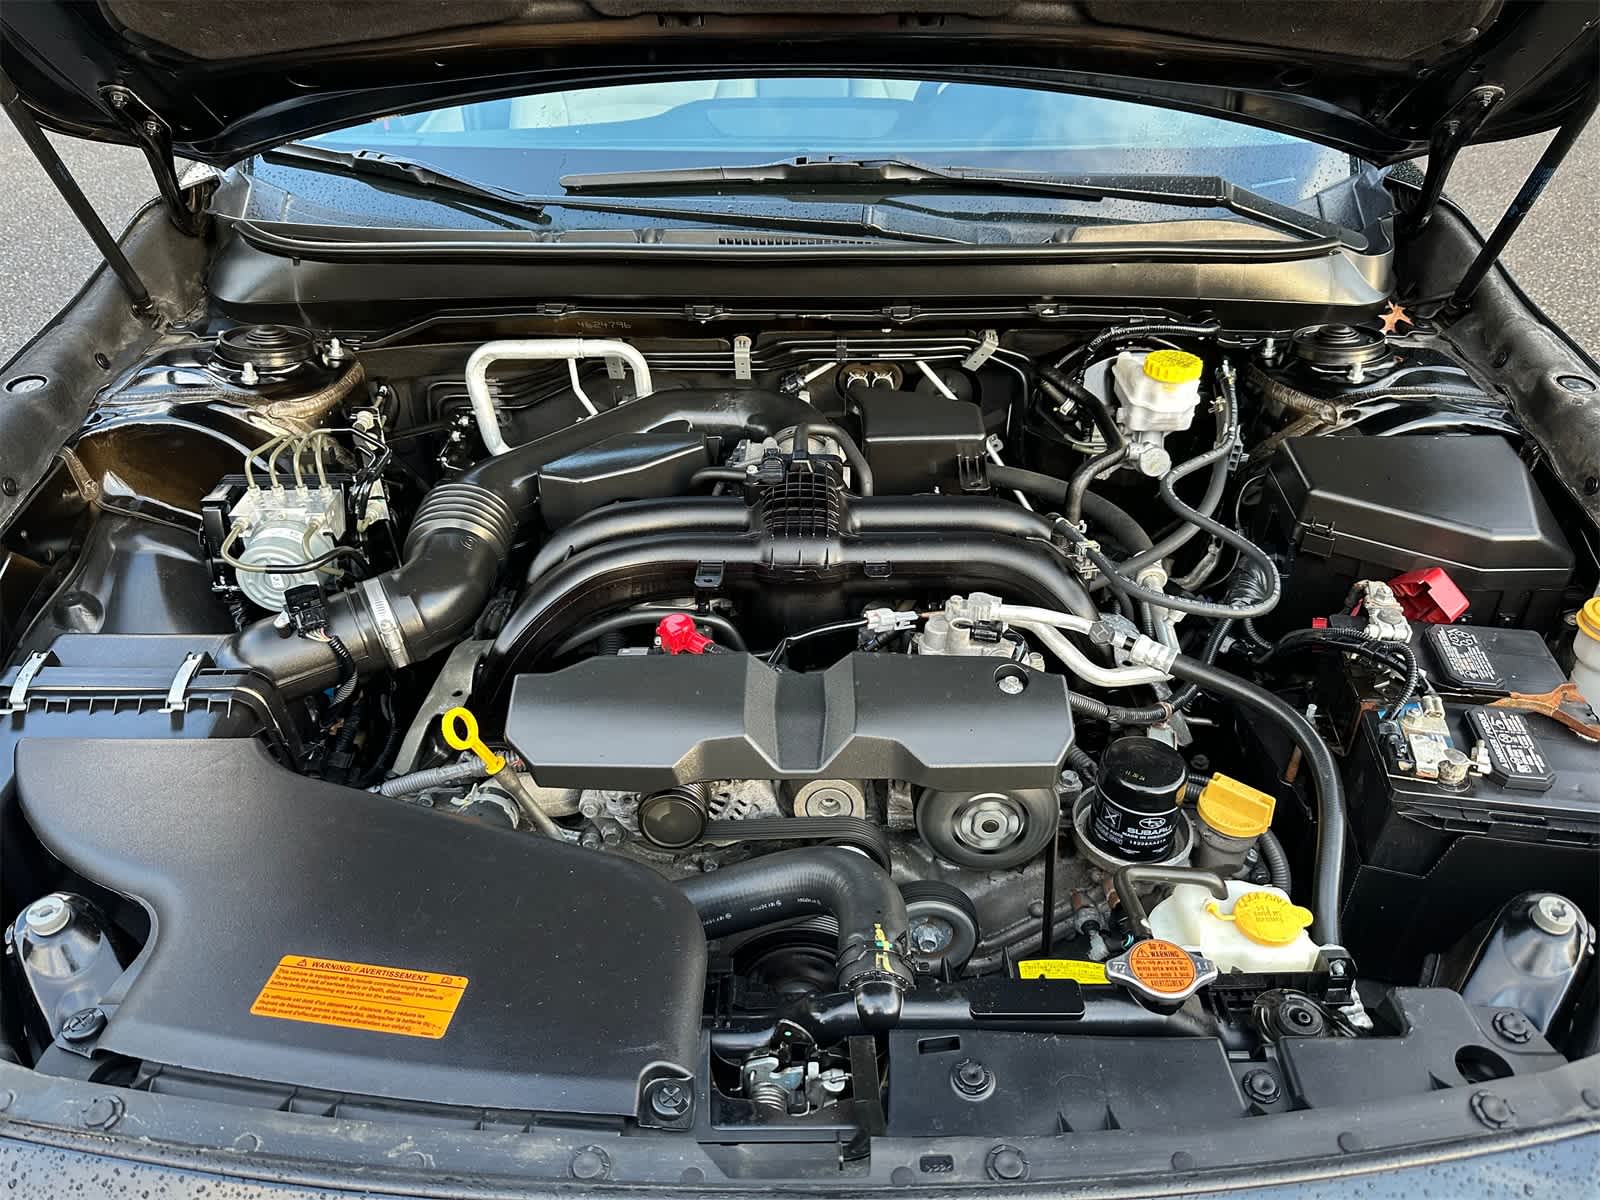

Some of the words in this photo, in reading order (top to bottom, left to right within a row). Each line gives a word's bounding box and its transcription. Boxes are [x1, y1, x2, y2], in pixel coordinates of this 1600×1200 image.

[1127, 824, 1172, 836] SUBARU
[1150, 950, 1180, 958] WARNING
[359, 967, 428, 980] AVERTISSEMENT
